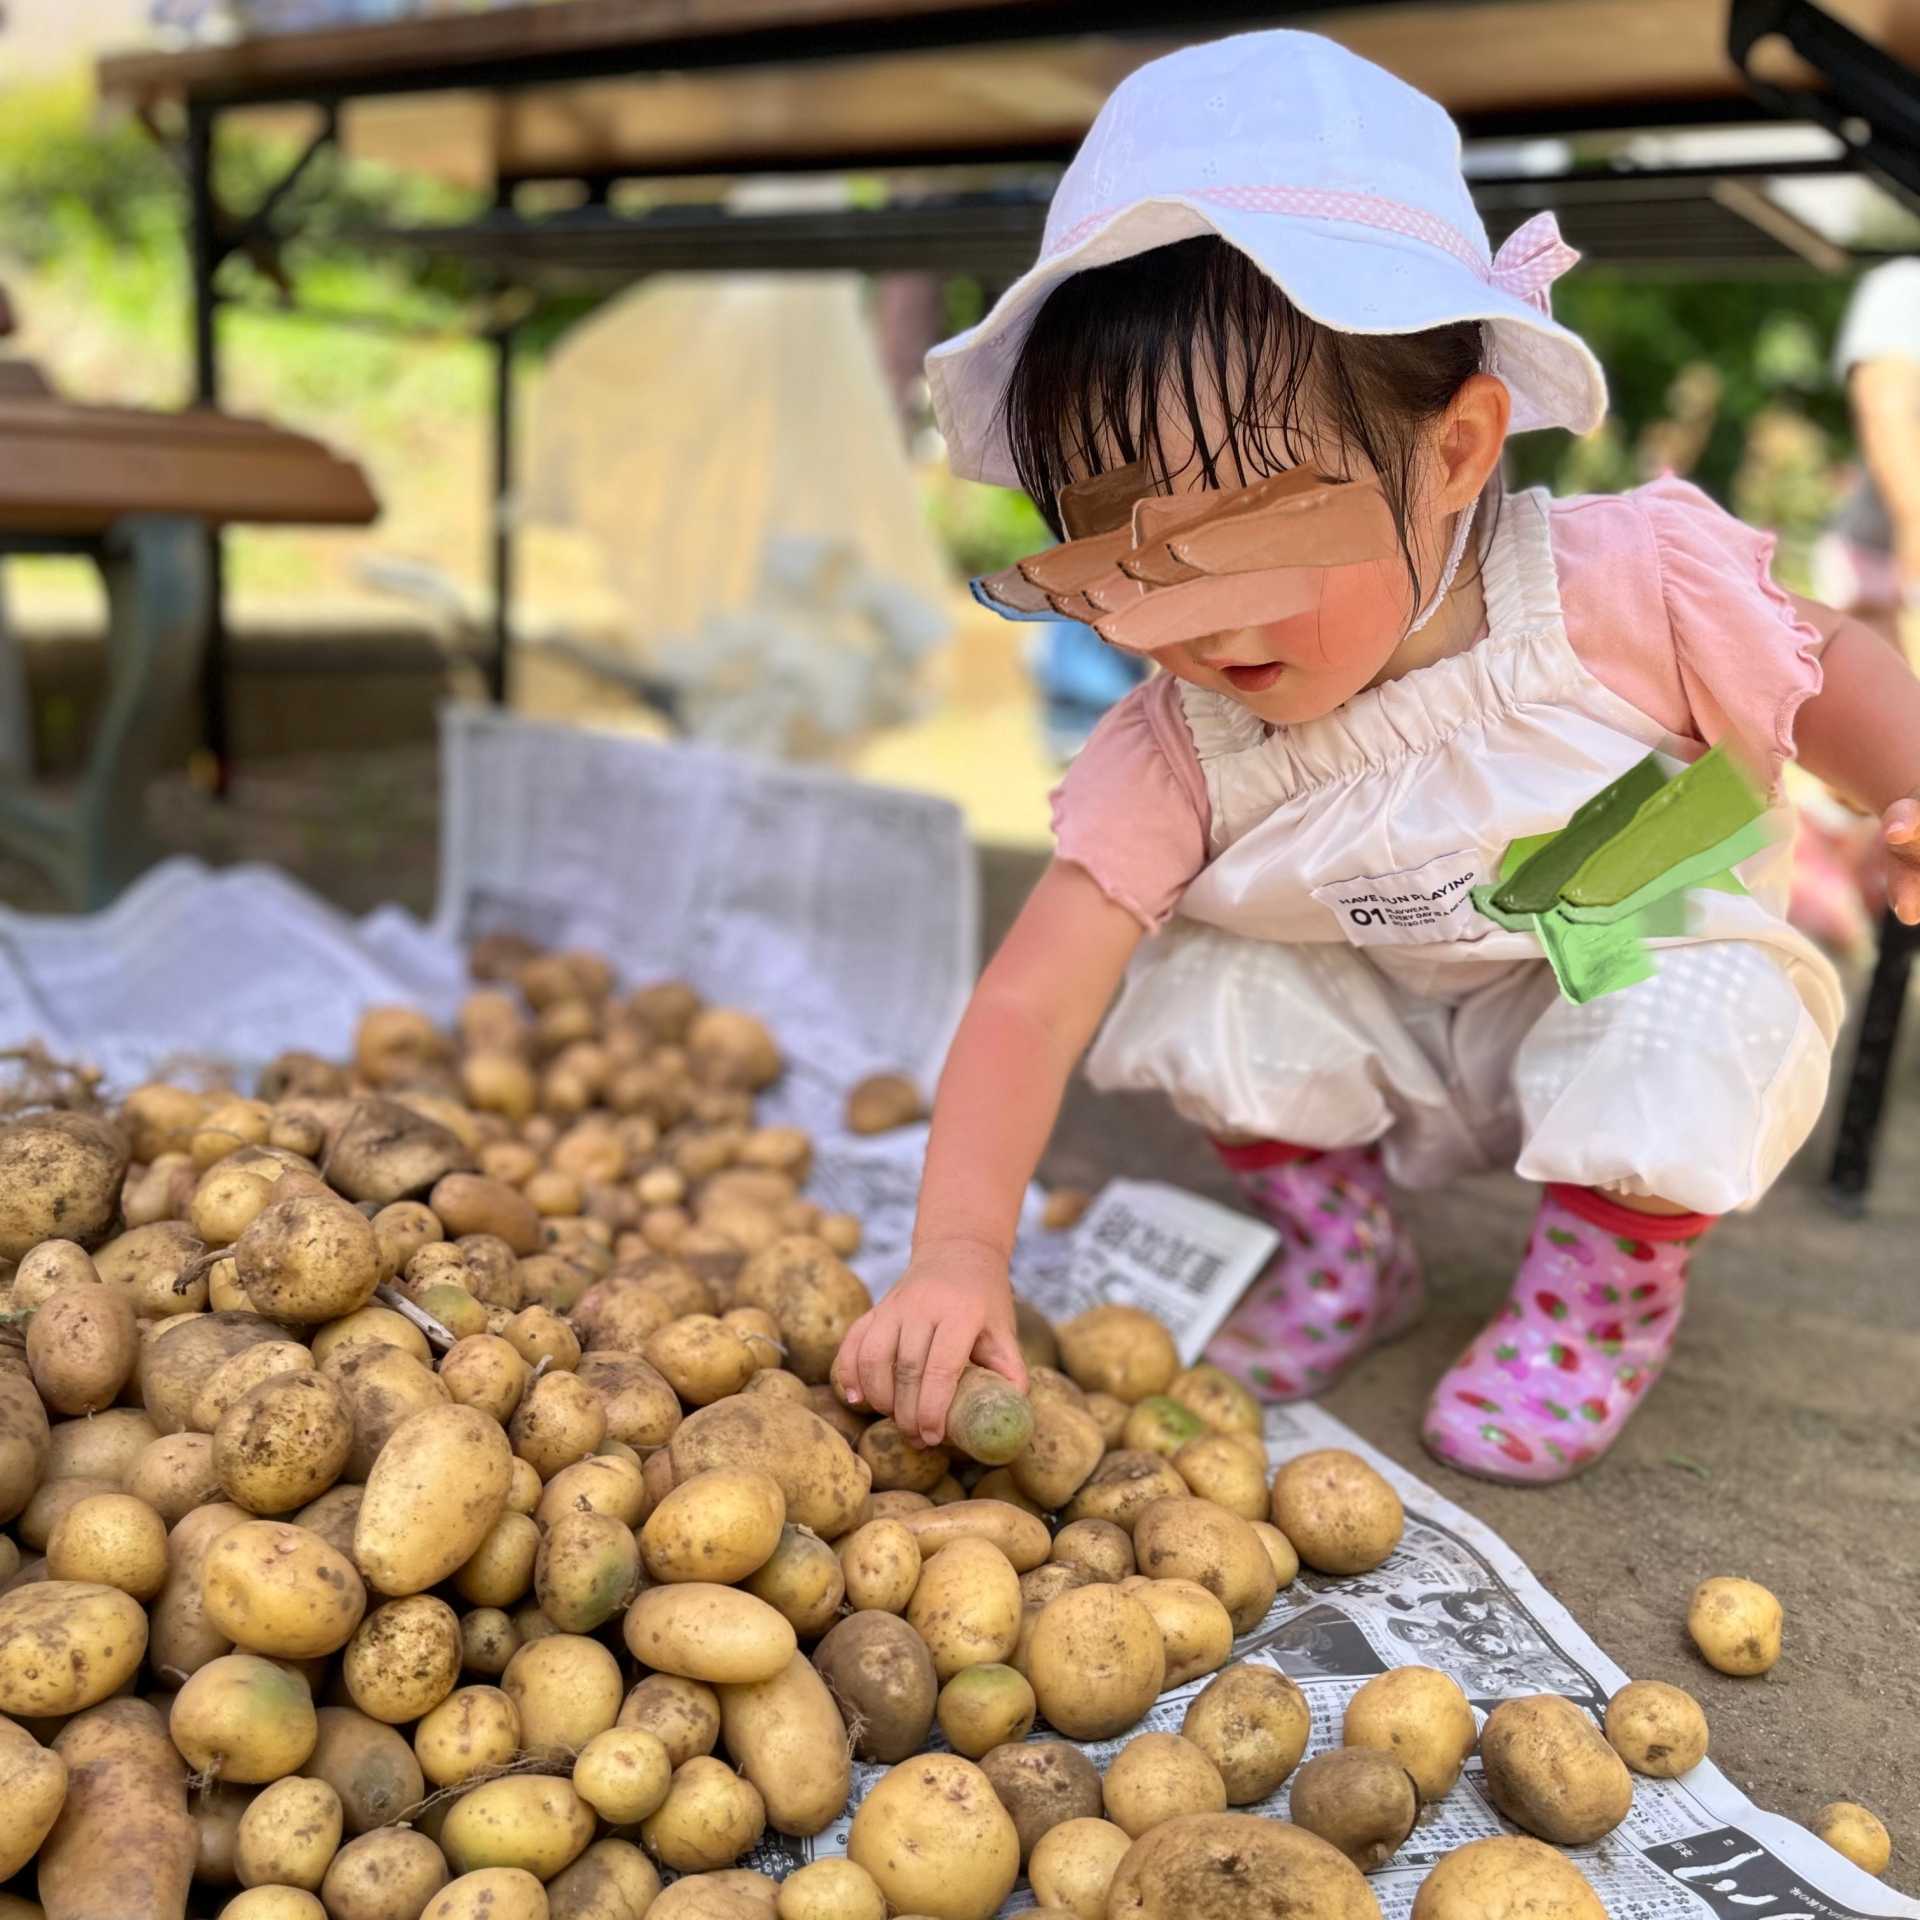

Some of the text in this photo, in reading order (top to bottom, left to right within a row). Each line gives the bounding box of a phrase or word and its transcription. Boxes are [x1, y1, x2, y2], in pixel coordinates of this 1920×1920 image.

[1339, 872, 1475, 905] HAVE FUN PLAYING
[1350, 908, 1387, 926] 01
[1415, 911, 1432, 919] DAY
